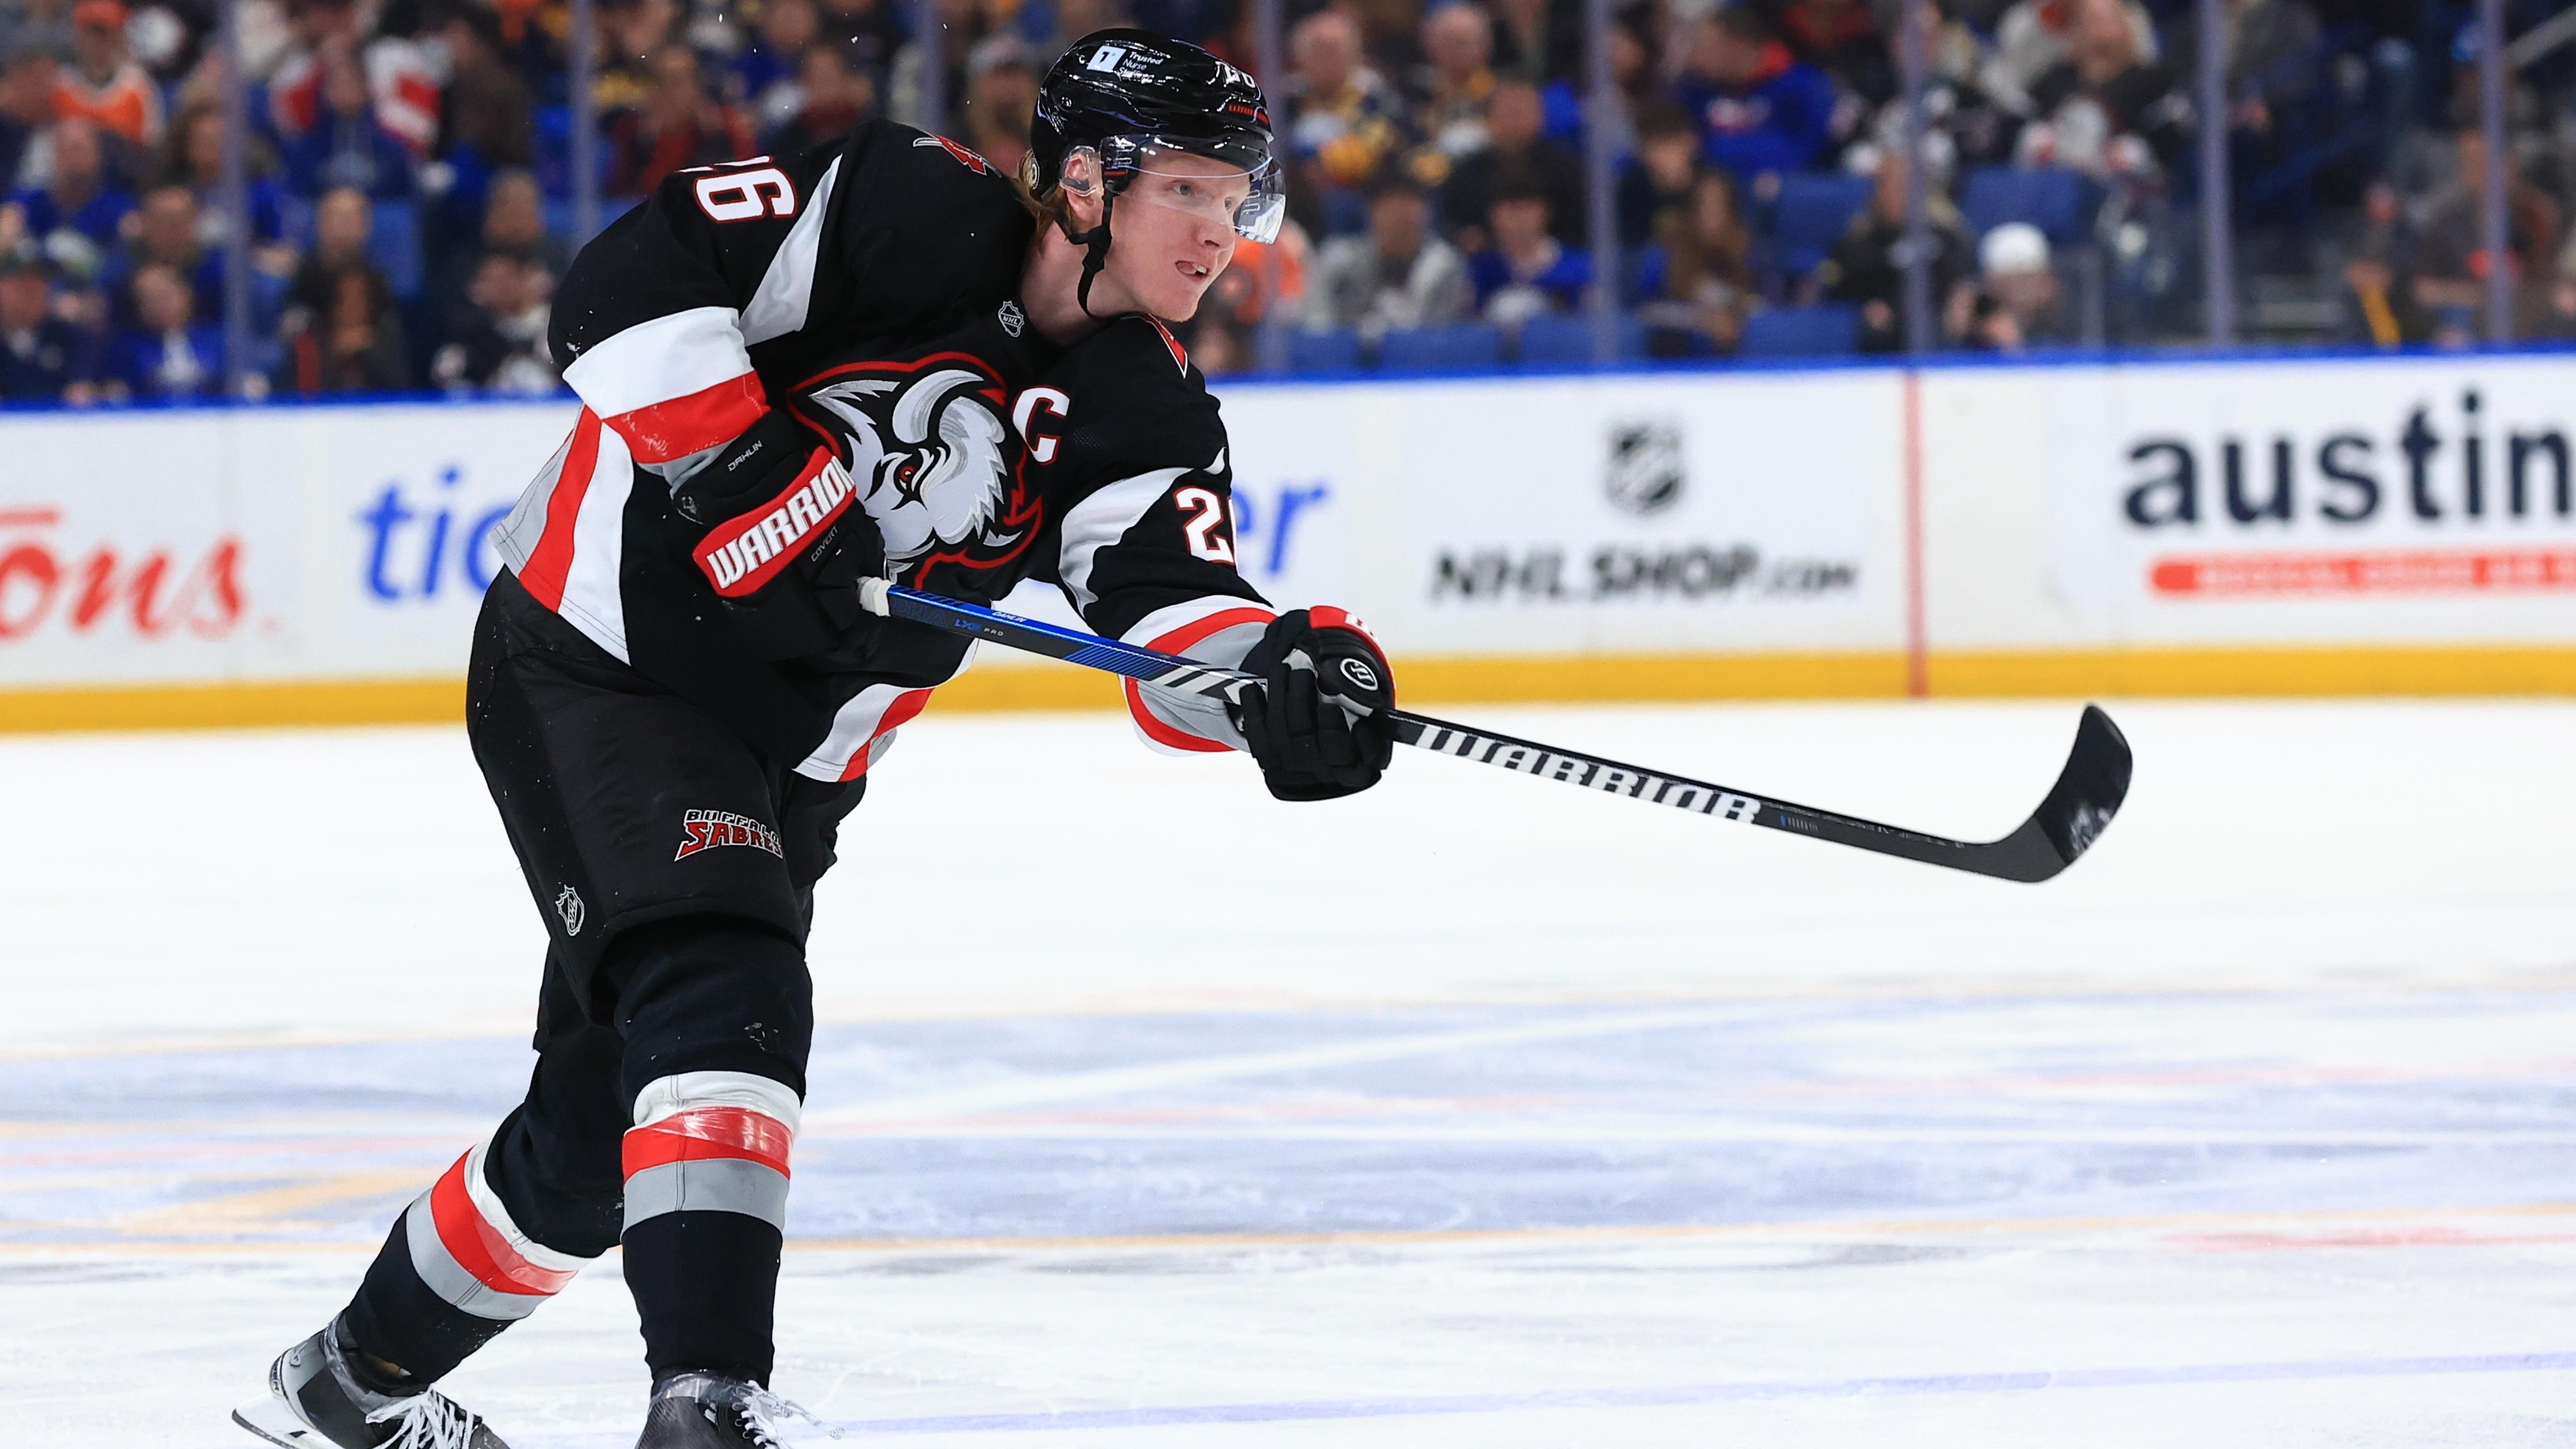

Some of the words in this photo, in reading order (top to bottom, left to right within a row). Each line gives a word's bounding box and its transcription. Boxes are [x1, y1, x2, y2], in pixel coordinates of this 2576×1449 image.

[1122, 58, 1147, 71] Nurse
[1129, 51, 1164, 65] Trusted
[674, 155, 799, 224] 6
[1012, 386, 1070, 464] C
[727, 440, 762, 471] DAHLIN
[2123, 389, 2571, 526] austin
[811, 525, 838, 562] COVERT
[1173, 486, 1238, 567] 2
[983, 627, 1004, 636] PRO
[1415, 723, 1761, 824] WARRIOR
[674, 821, 783, 862] SABRES
[684, 809, 780, 844] BUFFALO
